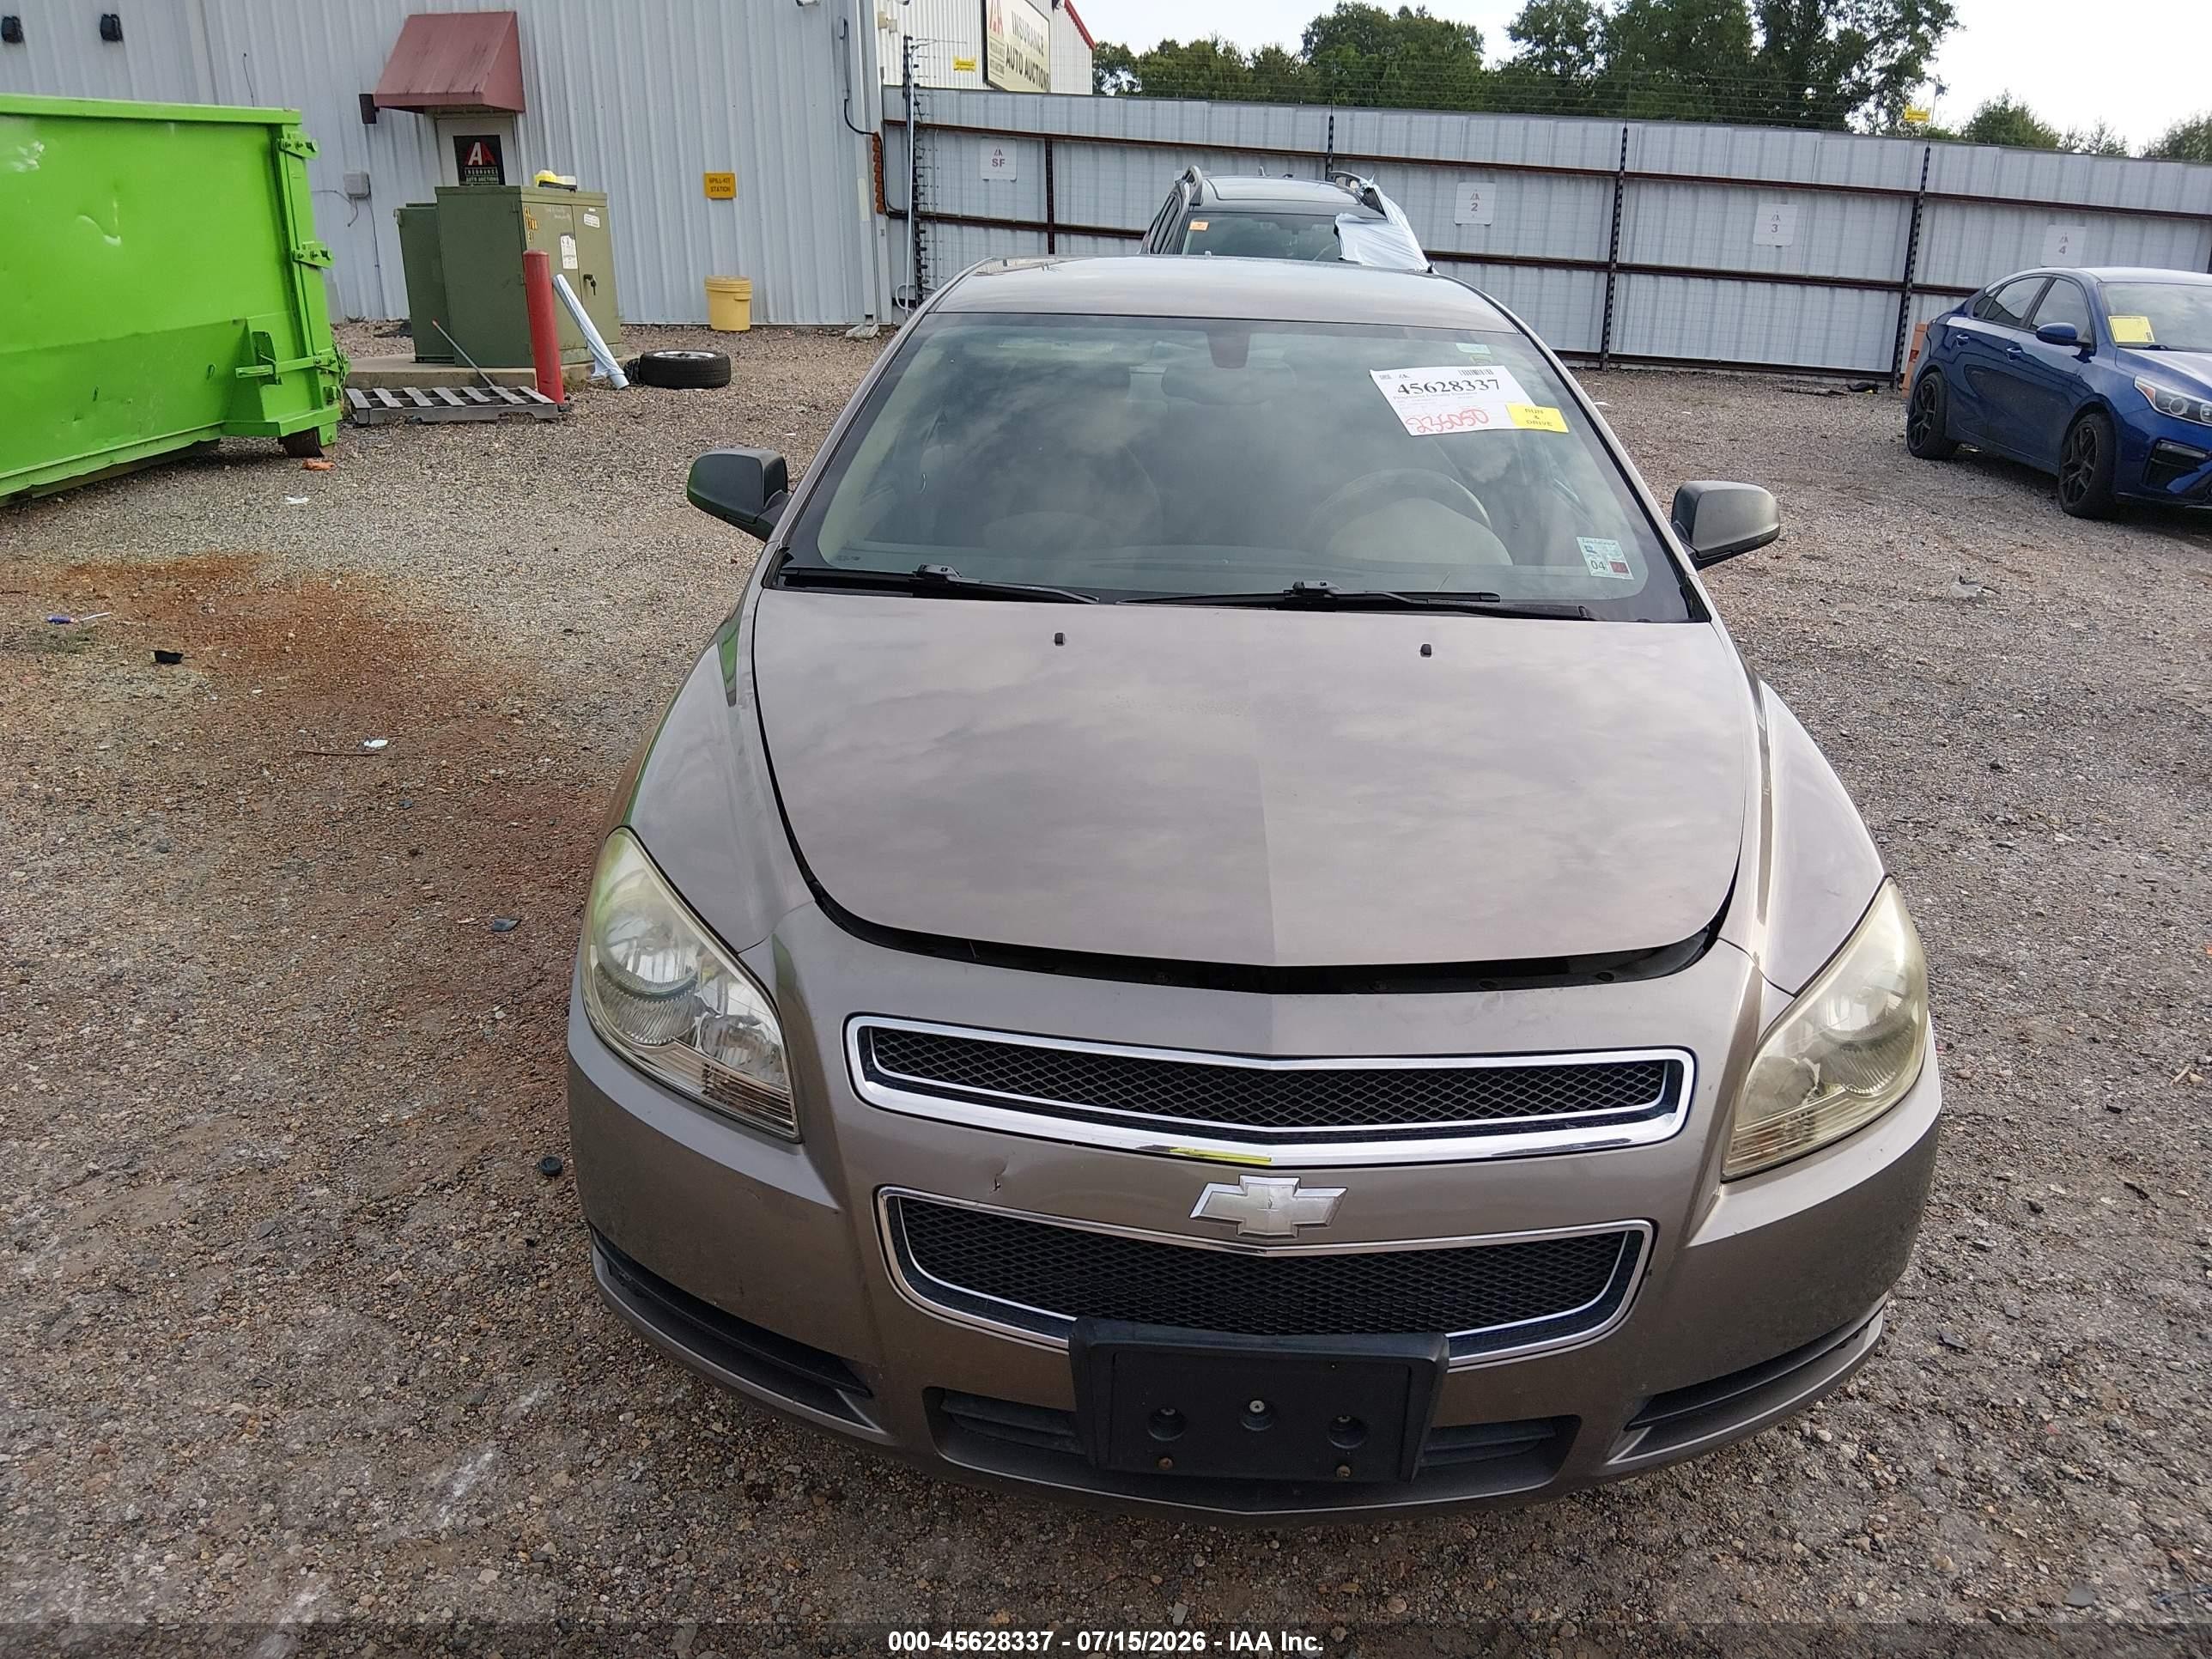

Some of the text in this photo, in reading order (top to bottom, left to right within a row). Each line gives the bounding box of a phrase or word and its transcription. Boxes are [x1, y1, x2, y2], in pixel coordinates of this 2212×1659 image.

[1011, 9, 1044, 58] INSURANCE
[1006, 42, 1024, 76] AUTO
[1024, 57, 1049, 91] AUCTIONS
[991, 158, 1006, 167] SF
[1470, 202, 1479, 212] 2
[1771, 223, 1778, 234] 3
[1397, 379, 1499, 395] 45628337
[1590, 561, 1606, 571] 04
